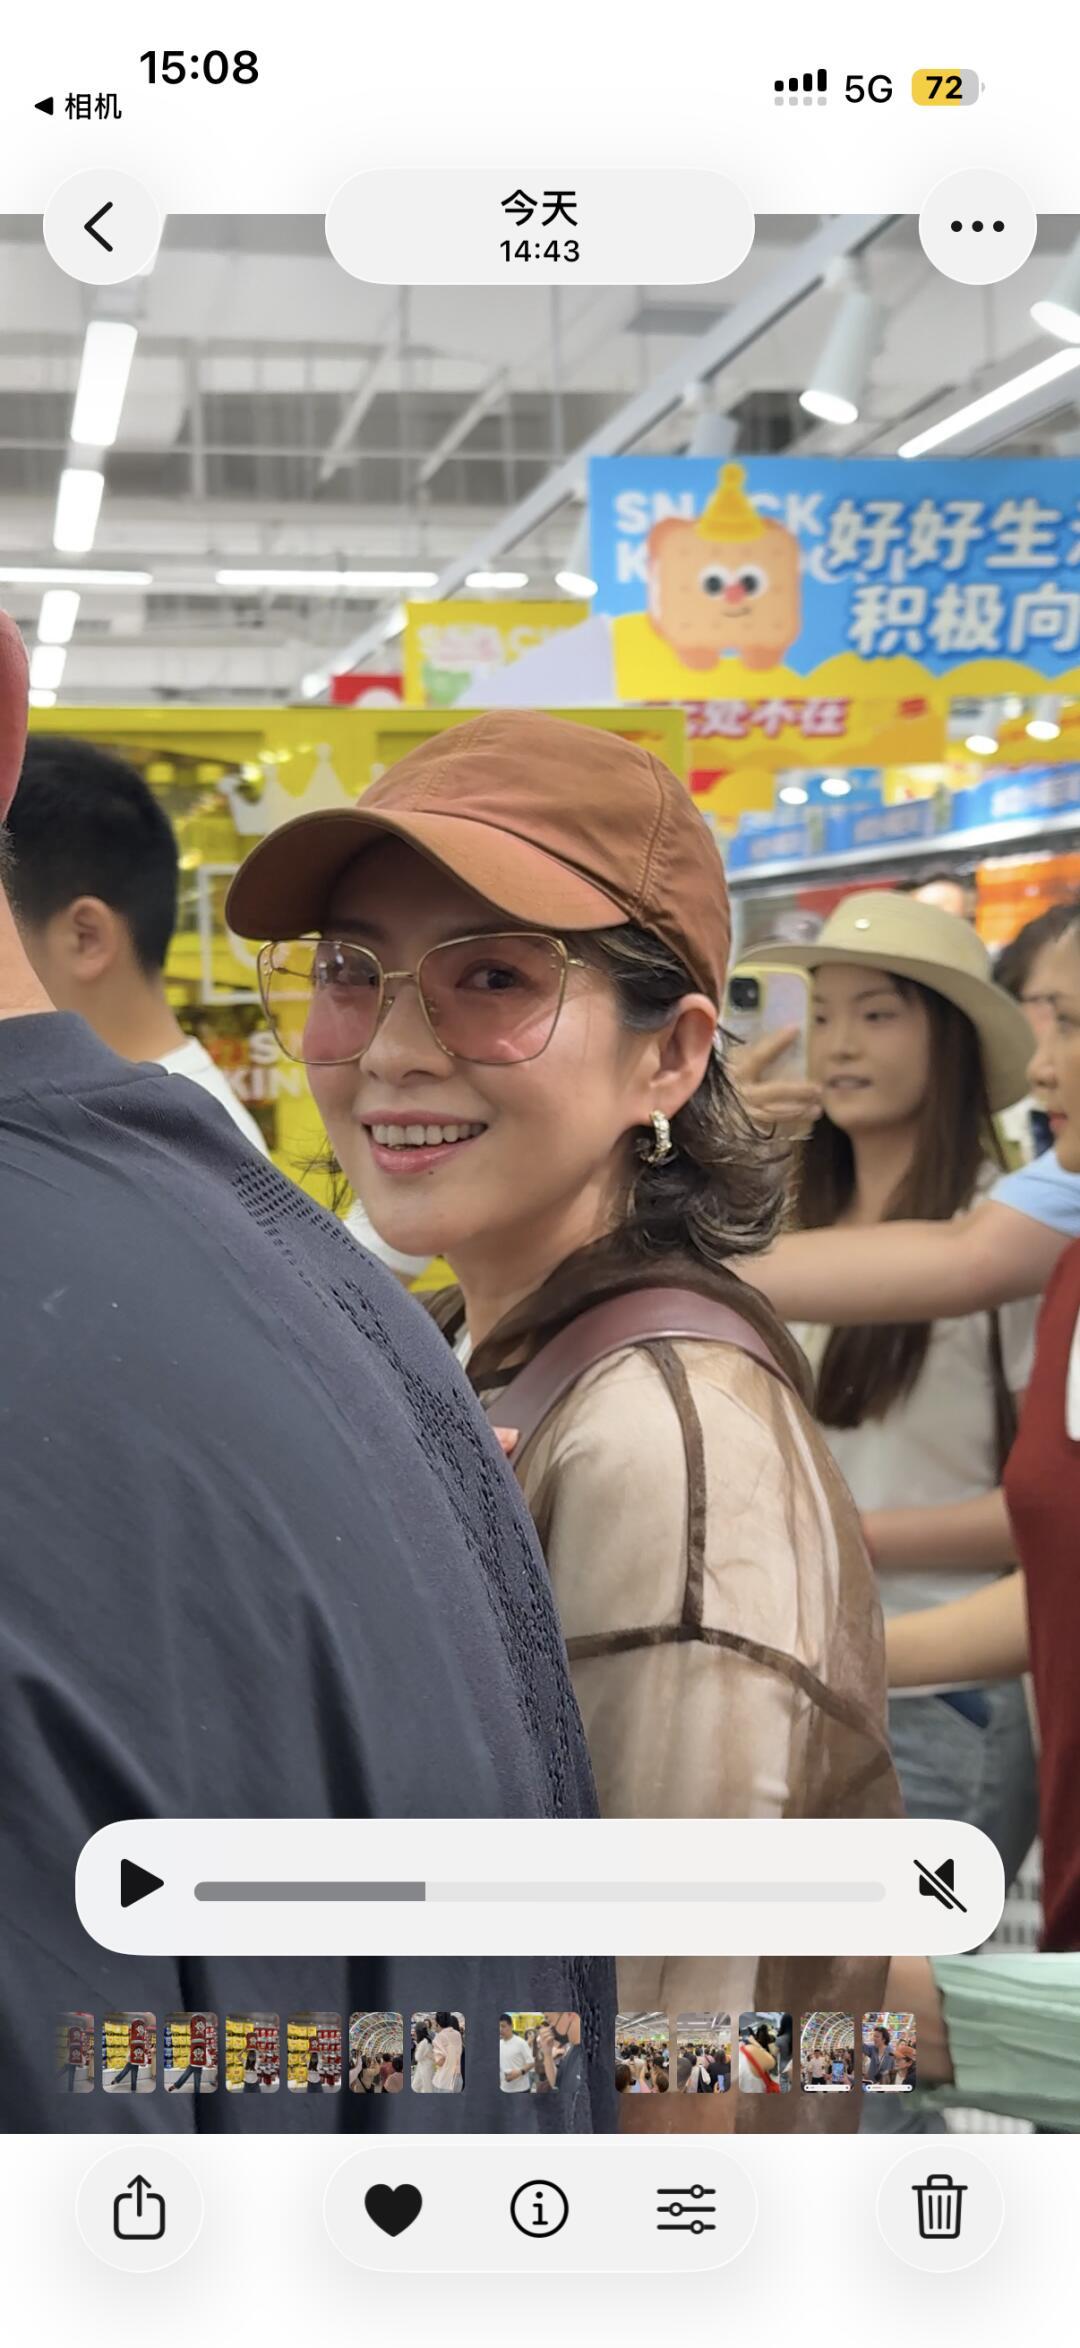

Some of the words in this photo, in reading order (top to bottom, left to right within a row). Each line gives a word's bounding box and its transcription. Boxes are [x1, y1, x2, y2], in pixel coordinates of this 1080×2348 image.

[615, 489, 823, 536] SNK
[828, 497, 1080, 571] 好好生
[848, 582, 1080, 653] 积极向
